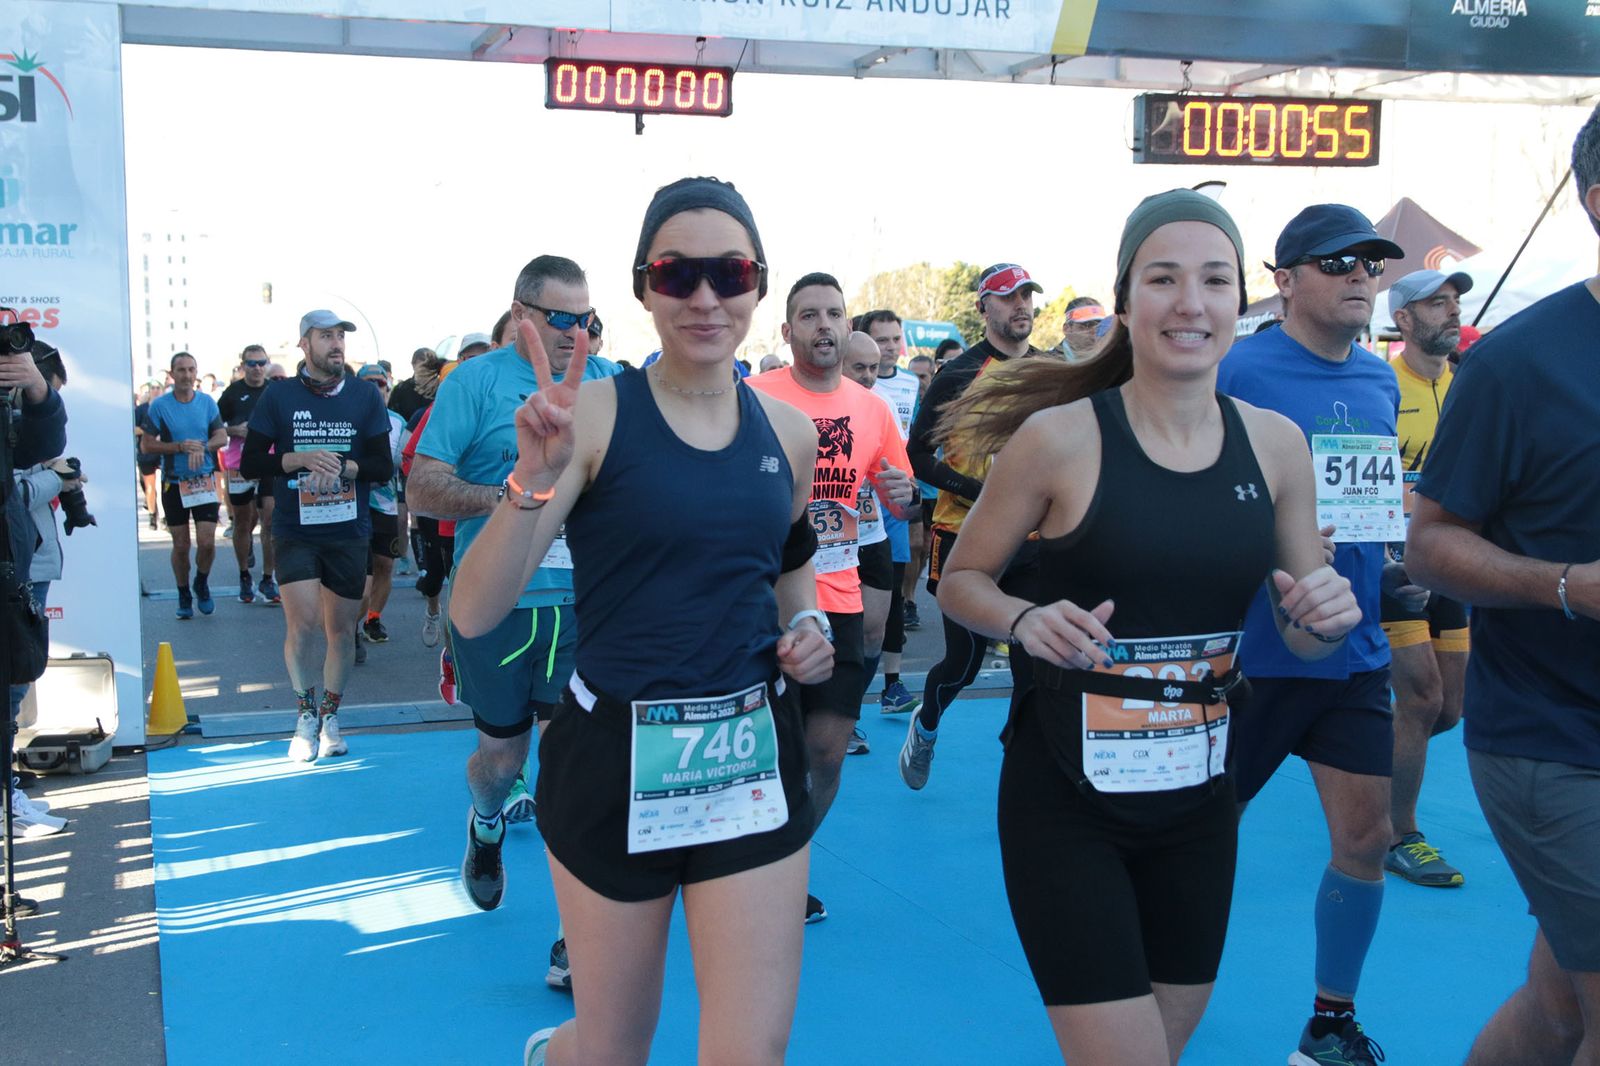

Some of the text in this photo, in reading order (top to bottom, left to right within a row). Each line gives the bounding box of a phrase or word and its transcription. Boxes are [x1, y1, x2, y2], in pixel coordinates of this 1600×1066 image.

[1470, 16, 1510, 28] CIUDAD
[0, 223, 78, 245] mar
[0, 248, 76, 259] AJA RURAL
[0, 296, 60, 304] ORT & SHOES
[293, 428, 351, 437] Almería 2022
[1325, 456, 1395, 486] 5144
[1342, 487, 1379, 495] JUAN FCO
[1160, 643, 1192, 651] Maratón
[1135, 650, 1192, 660] Almería 2022
[711, 700, 736, 710] Maratón
[684, 706, 736, 720] Almería 2022
[1148, 708, 1193, 723] MARTA
[672, 717, 756, 769] 746
[662, 770, 702, 784] MARIA
[707, 759, 757, 779] VICTORIA
